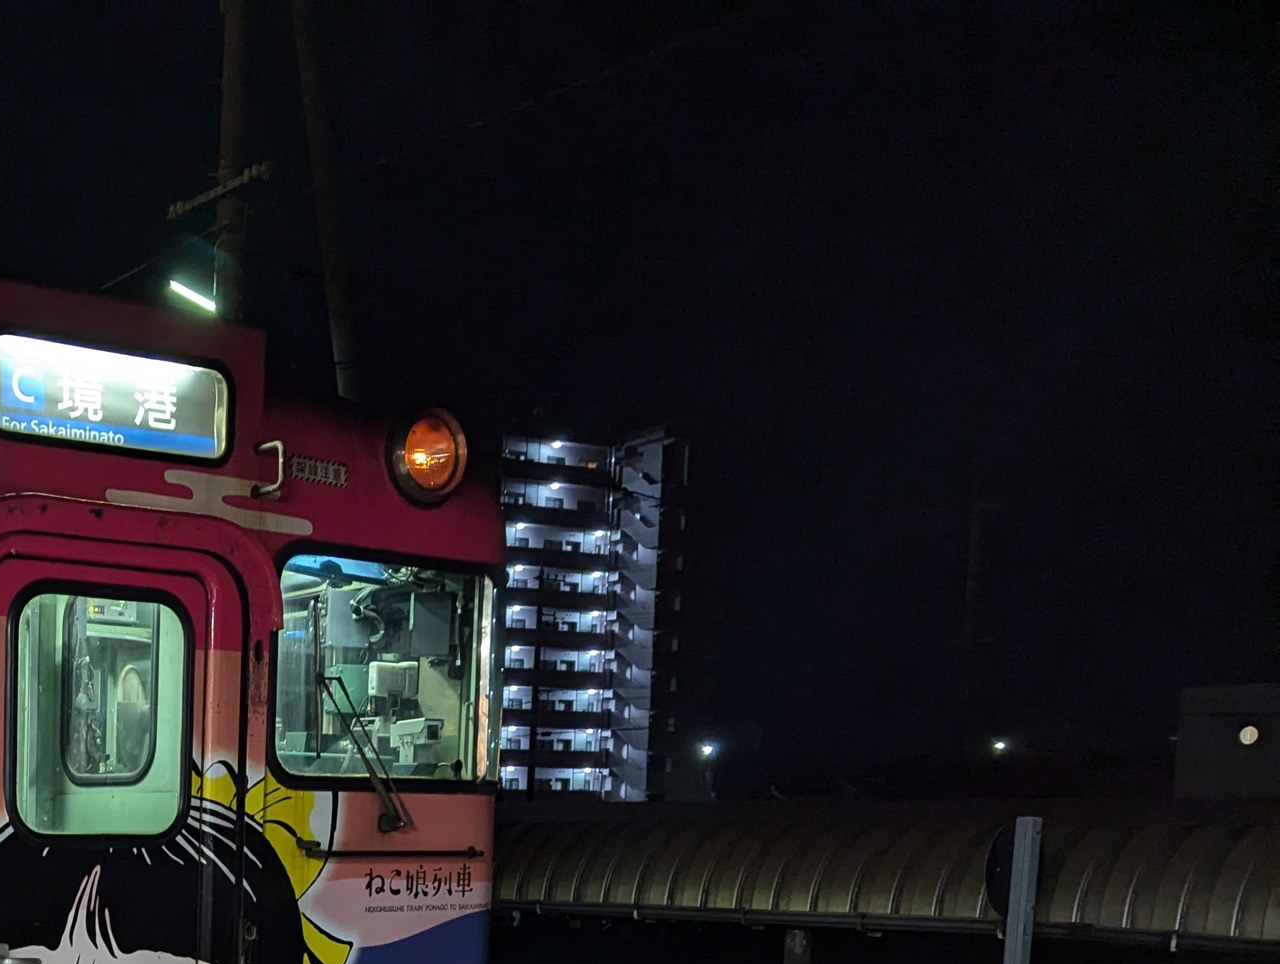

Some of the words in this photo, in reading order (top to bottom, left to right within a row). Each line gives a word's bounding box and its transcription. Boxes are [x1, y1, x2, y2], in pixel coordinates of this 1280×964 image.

[12, 366, 35, 403] C
[57, 372, 178, 430] 境港
[1, 416, 27, 431] For
[30, 419, 125, 445] Sakaiminato
[364, 863, 474, 899] ねこ娘列車
[406, 904, 424, 913] TRAIN
